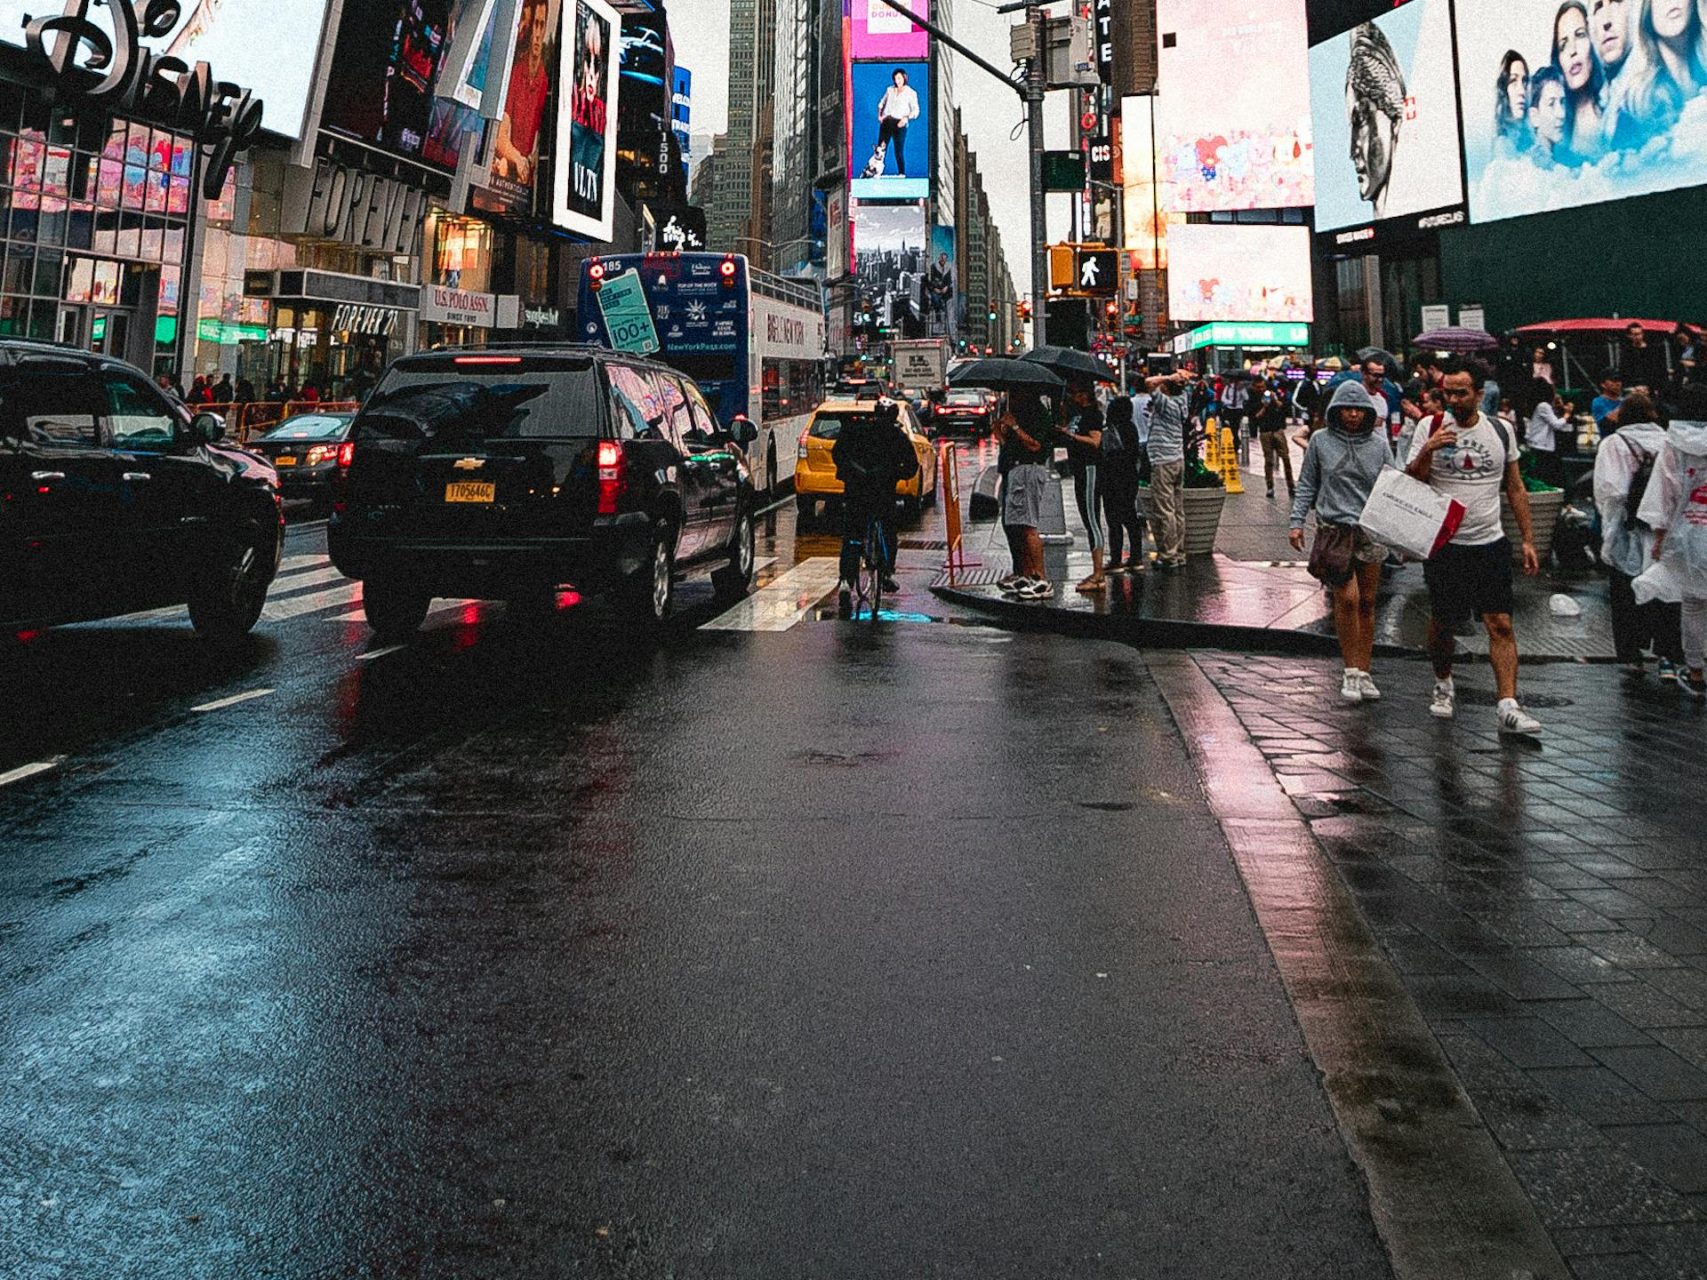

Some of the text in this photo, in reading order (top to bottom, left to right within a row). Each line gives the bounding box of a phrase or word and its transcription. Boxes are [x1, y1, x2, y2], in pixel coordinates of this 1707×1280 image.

[658, 131, 670, 174] 1500
[303, 155, 429, 257] FOREVER
[449, 291, 468, 310] POLO
[331, 304, 384, 336] FOREVER
[611, 322, 650, 344] 100+
